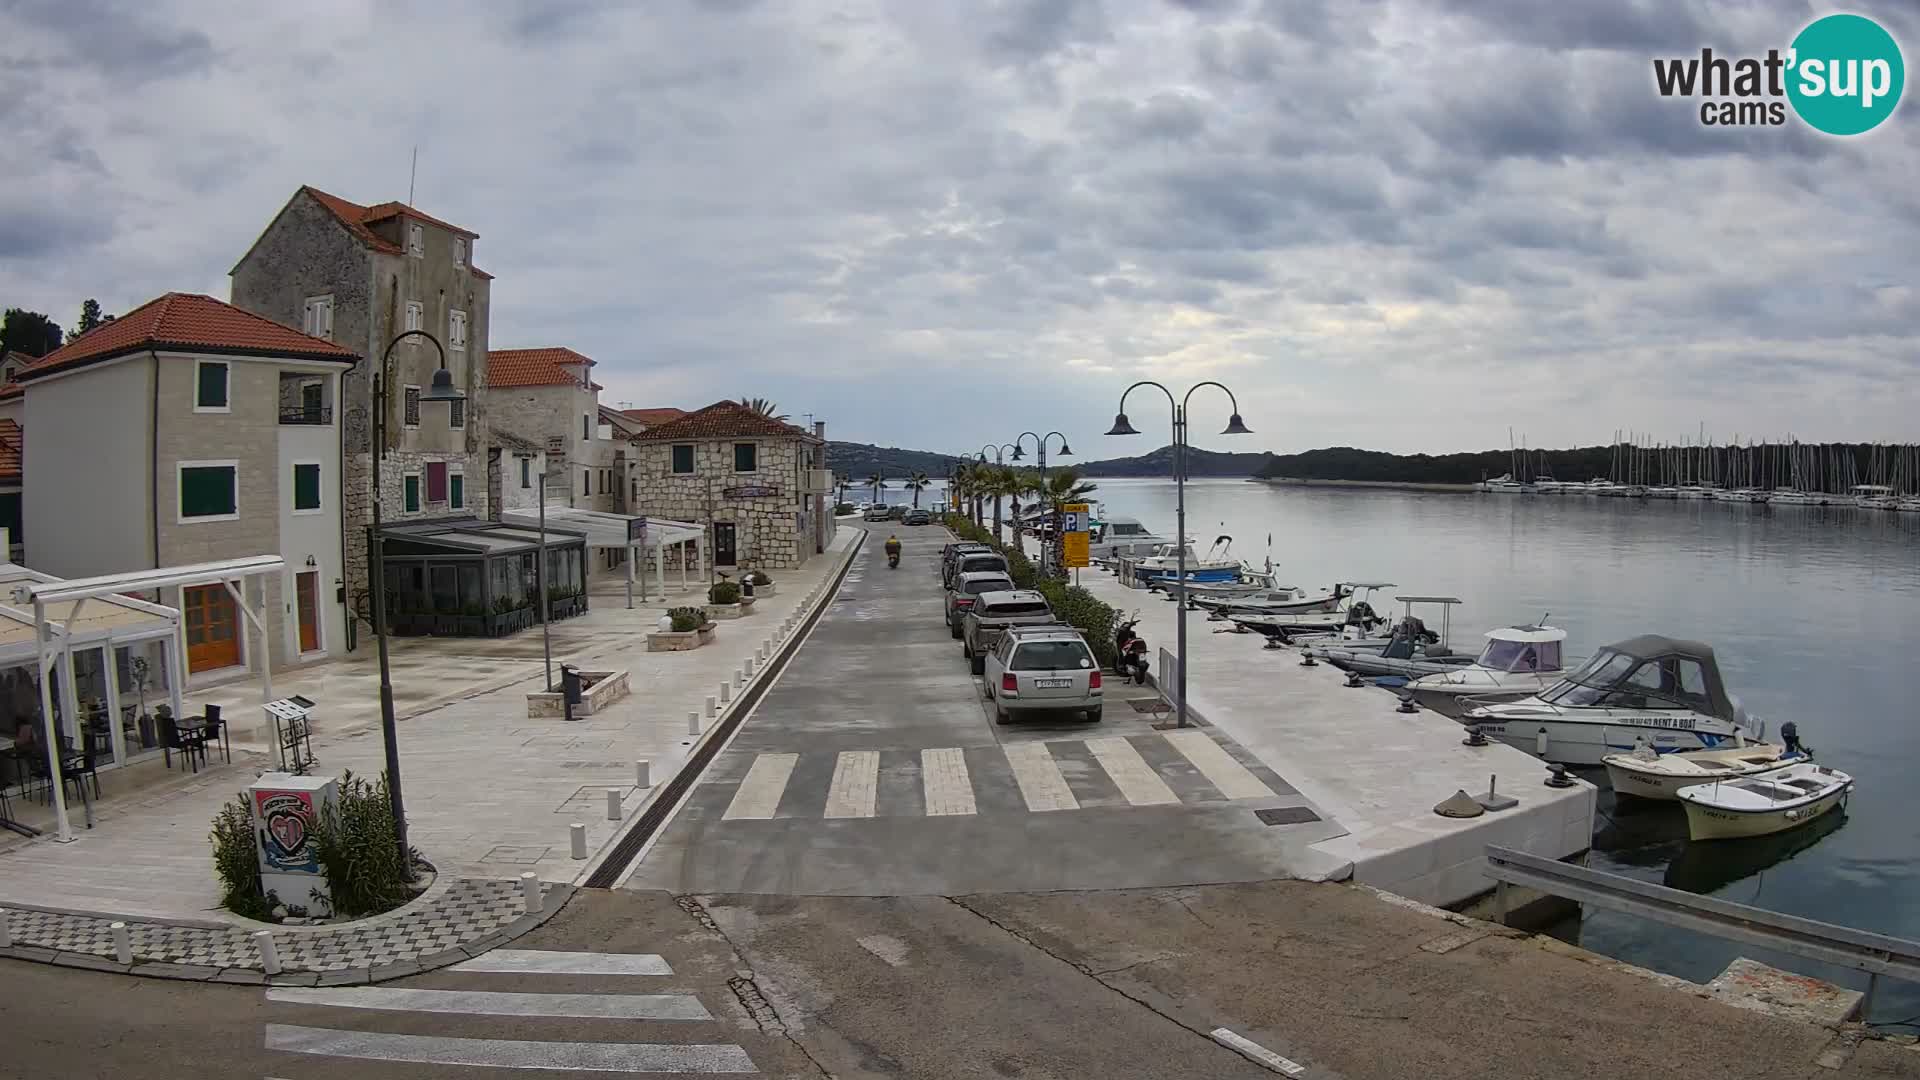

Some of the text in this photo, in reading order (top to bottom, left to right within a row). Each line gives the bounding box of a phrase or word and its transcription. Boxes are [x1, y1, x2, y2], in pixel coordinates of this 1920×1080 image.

[1065, 514, 1076, 530] P
[1653, 718, 1672, 728] RENT
[1673, 718, 1678, 728] A
[1679, 718, 1697, 729] BOAT
